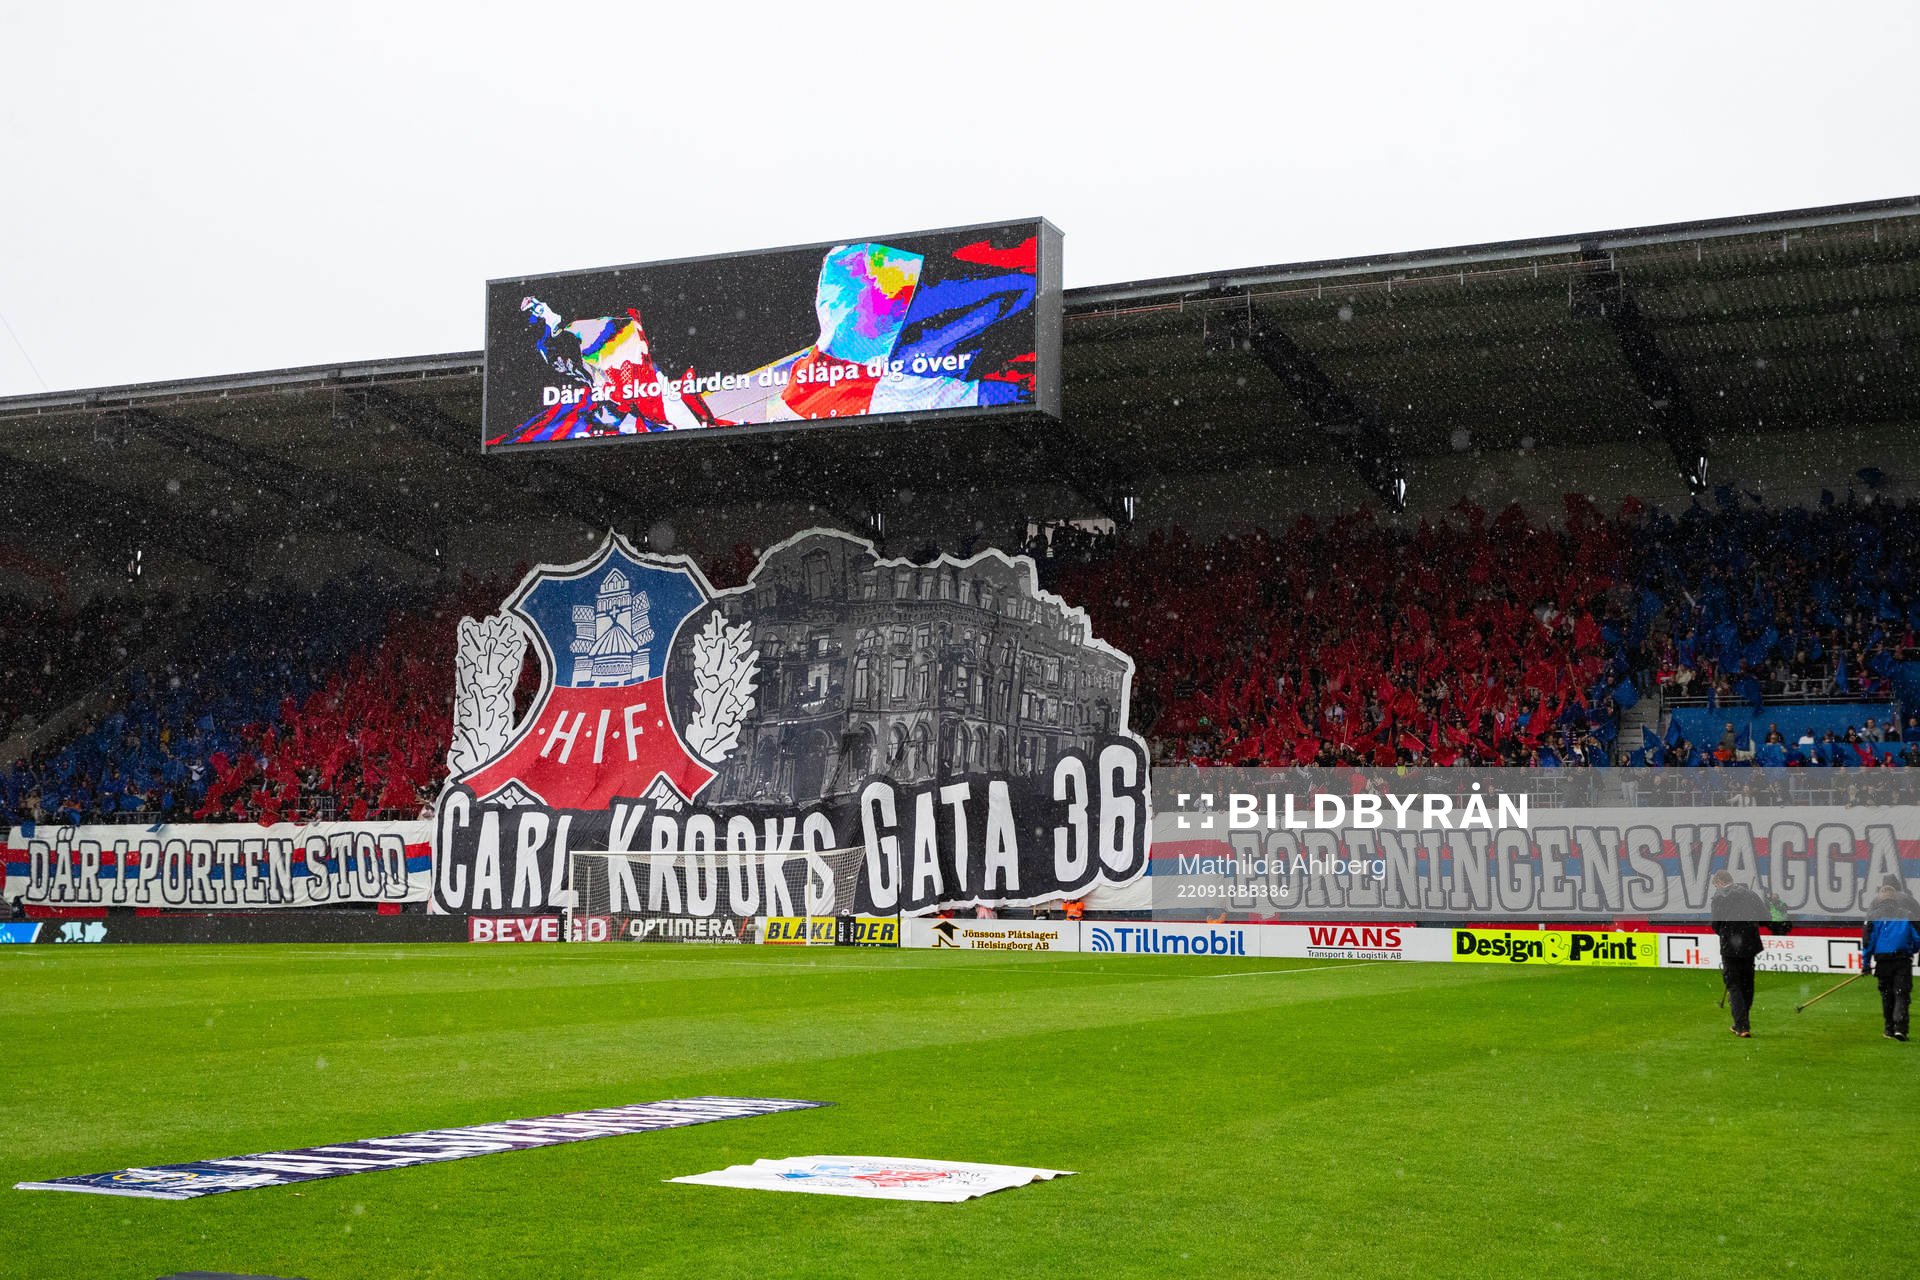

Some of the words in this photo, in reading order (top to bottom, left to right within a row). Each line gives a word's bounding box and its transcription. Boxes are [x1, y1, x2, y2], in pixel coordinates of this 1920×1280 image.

[543, 384, 585, 406] Där
[590, 380, 615, 402] är
[622, 371, 750, 400] skolgården
[758, 367, 788, 387] du
[796, 361, 859, 388] släpa
[867, 358, 904, 382] dig
[912, 352, 971, 373] över
[440, 791, 579, 910] CARL
[607, 803, 836, 917] KROOKS
[861, 780, 1020, 908] GATA
[1053, 744, 1138, 882] 36
[26, 827, 102, 902] DÄR
[112, 839, 129, 903] I
[135, 838, 295, 904] PORTEN
[305, 831, 409, 900] STOD
[630, 918, 737, 938] OPTIMERA
[767, 917, 895, 940] BLÅKLDER
[962, 929, 1006, 939] Jönssons
[1007, 930, 1058, 941] Plåtslageri
[1308, 927, 1402, 948] WANS
[977, 940, 1033, 950] Helsingborg
[1035, 942, 1050, 950] AB
[1114, 928, 1246, 955] Tillmobil
[1307, 950, 1345, 959] Transport
[1347, 951, 1353, 959] &
[1356, 951, 1389, 960] Logistik
[1390, 952, 1402, 960] AB
